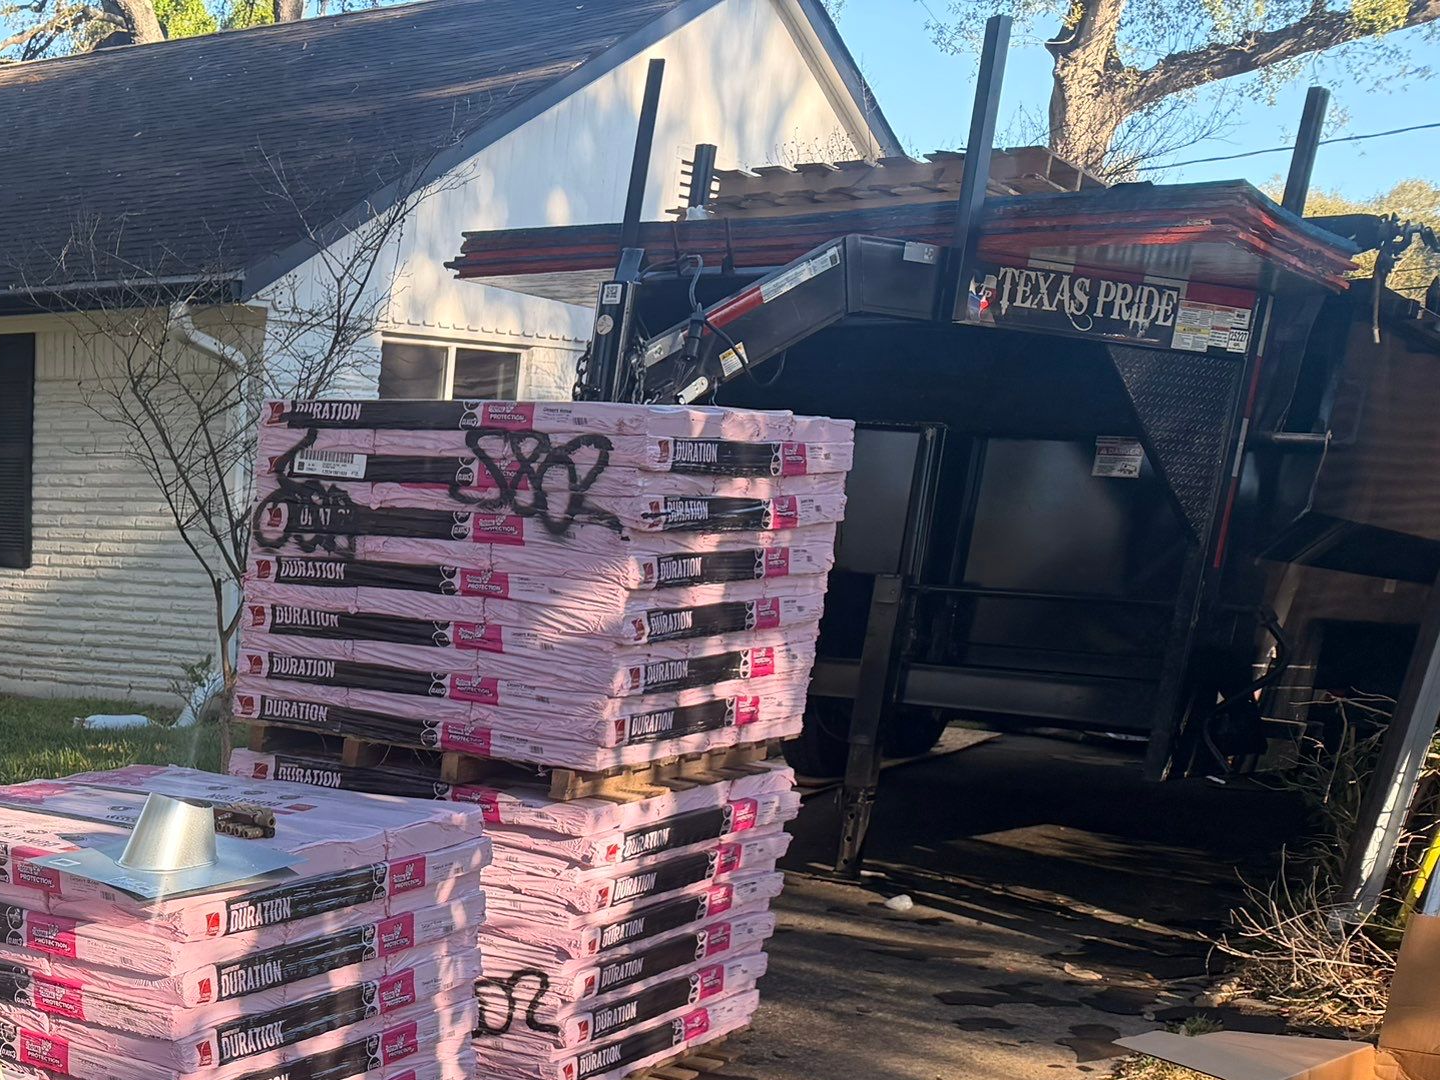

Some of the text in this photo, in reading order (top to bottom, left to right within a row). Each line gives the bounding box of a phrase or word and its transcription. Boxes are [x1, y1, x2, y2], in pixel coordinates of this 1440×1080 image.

[998, 266, 1093, 332] TEXAS
[1093, 279, 1180, 332] PRIDE
[675, 441, 718, 462] DURATION
[279, 560, 345, 580] DURATION
[660, 556, 702, 580] DURATION
[275, 606, 340, 628] DURATION
[650, 610, 693, 634] DURATION
[272, 657, 335, 678] DURATION
[646, 660, 689, 685] DURATION
[264, 700, 329, 722] DURATION
[631, 710, 675, 736] DURATION
[623, 826, 671, 857] DURATION
[19, 872, 52, 886] PROTECTION
[613, 872, 658, 902] DURATION
[229, 897, 291, 928] DURATION
[34, 936, 68, 950] PROTECTION
[601, 917, 646, 949] DURATION
[221, 960, 283, 991] DURATION
[601, 957, 644, 987] DURATION
[42, 998, 75, 1011] PROTECTION
[595, 1001, 638, 1033] DURATION
[221, 1021, 284, 1058] DURATION
[27, 1050, 61, 1066] PROTECTION
[579, 1044, 622, 1075] DURATION
